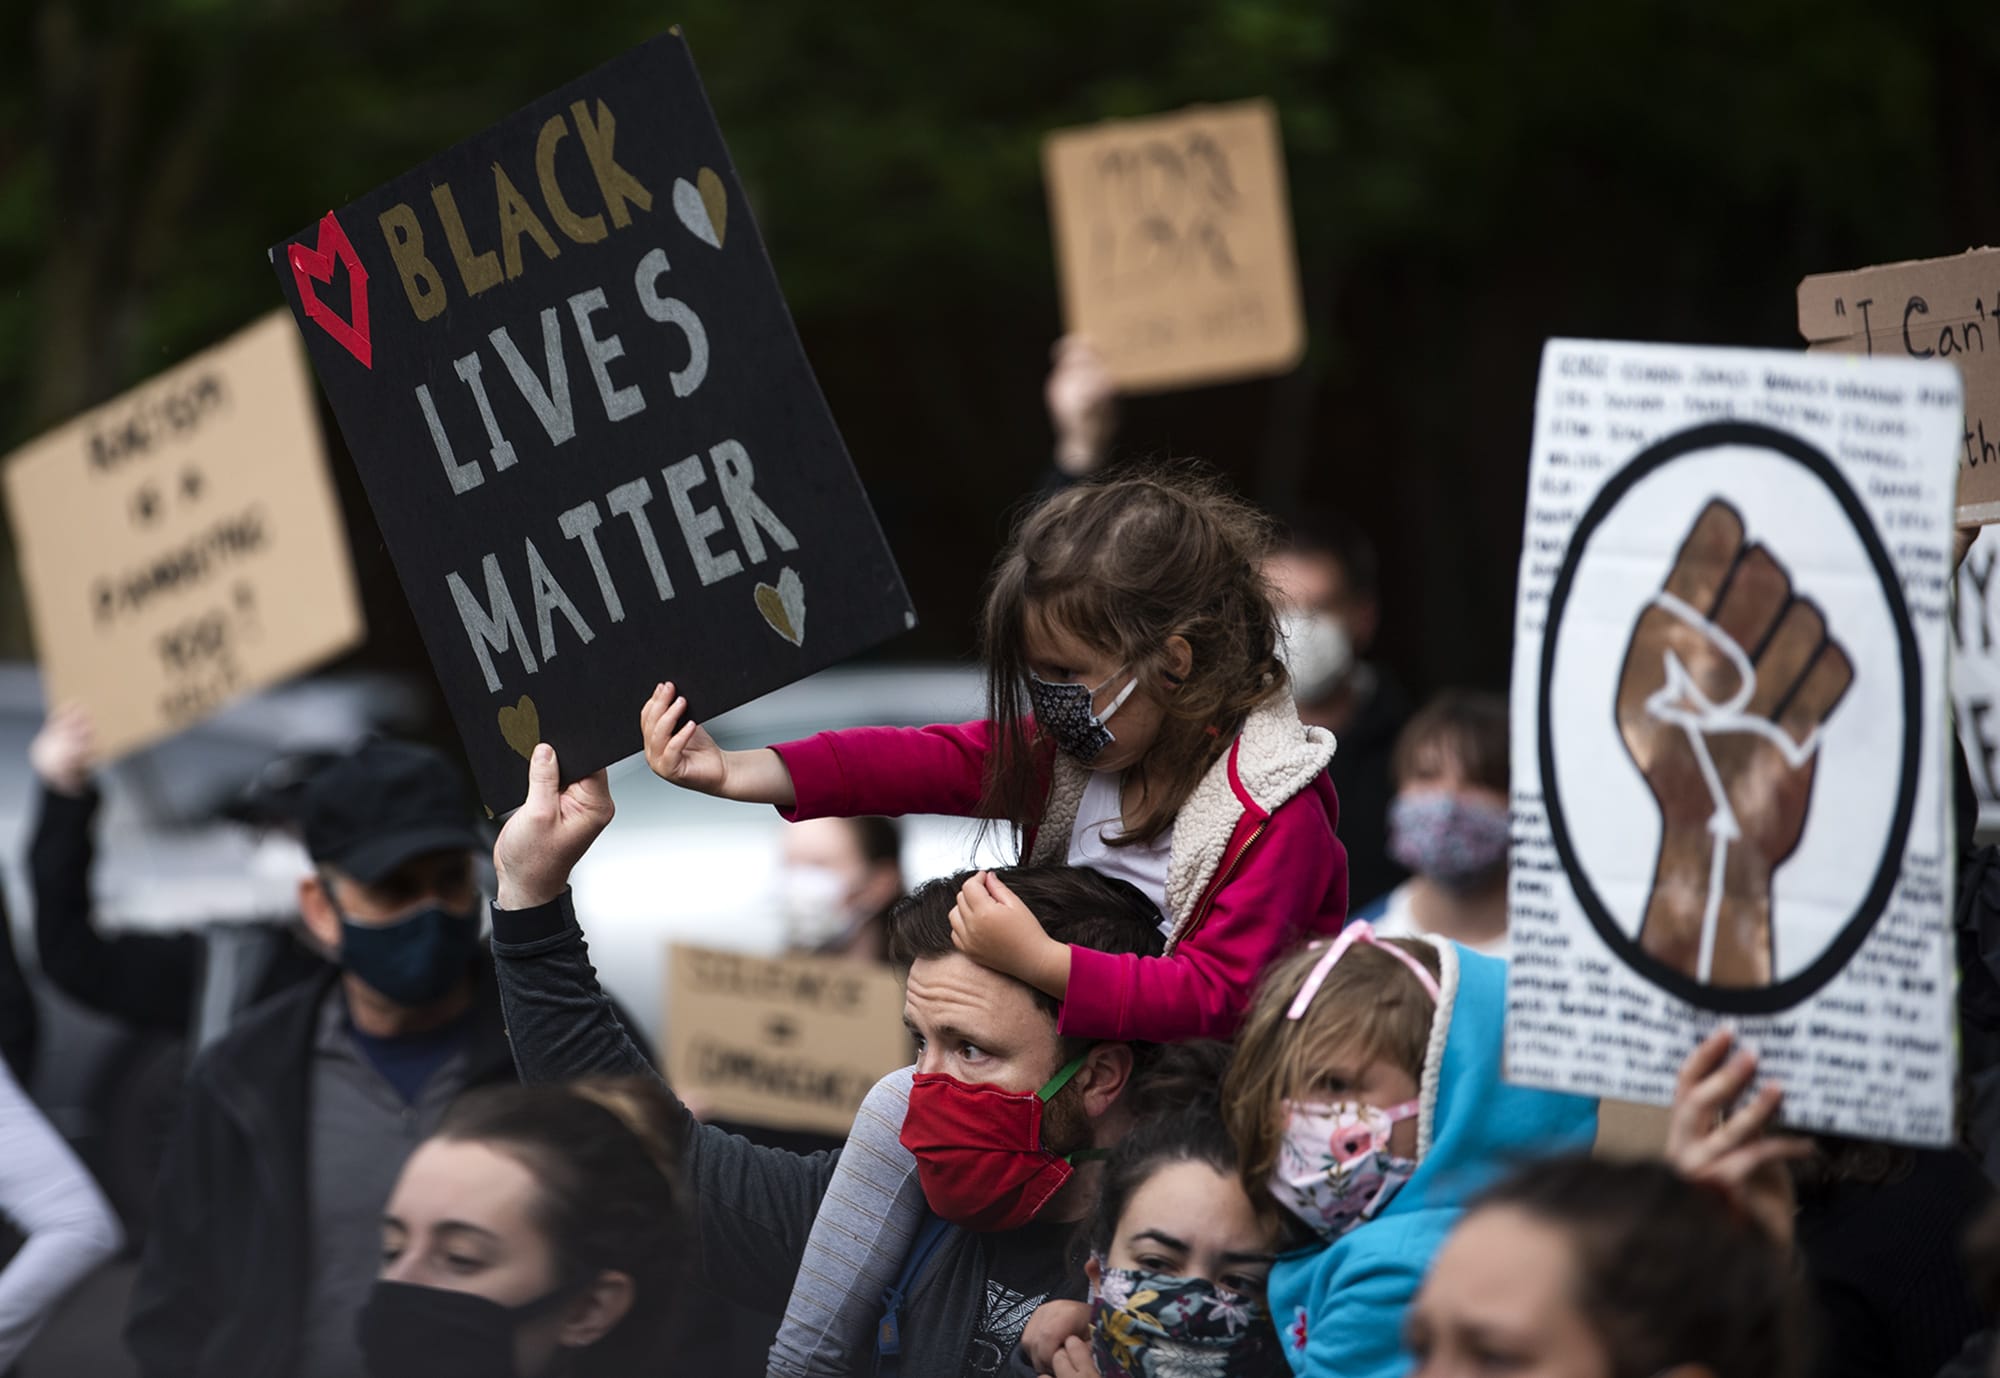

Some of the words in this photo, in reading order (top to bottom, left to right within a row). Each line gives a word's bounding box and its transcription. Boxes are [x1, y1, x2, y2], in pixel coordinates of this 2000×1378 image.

[378, 97, 653, 322] BLACK
[415, 248, 711, 496] LIVES
[444, 438, 800, 694] MATTER
